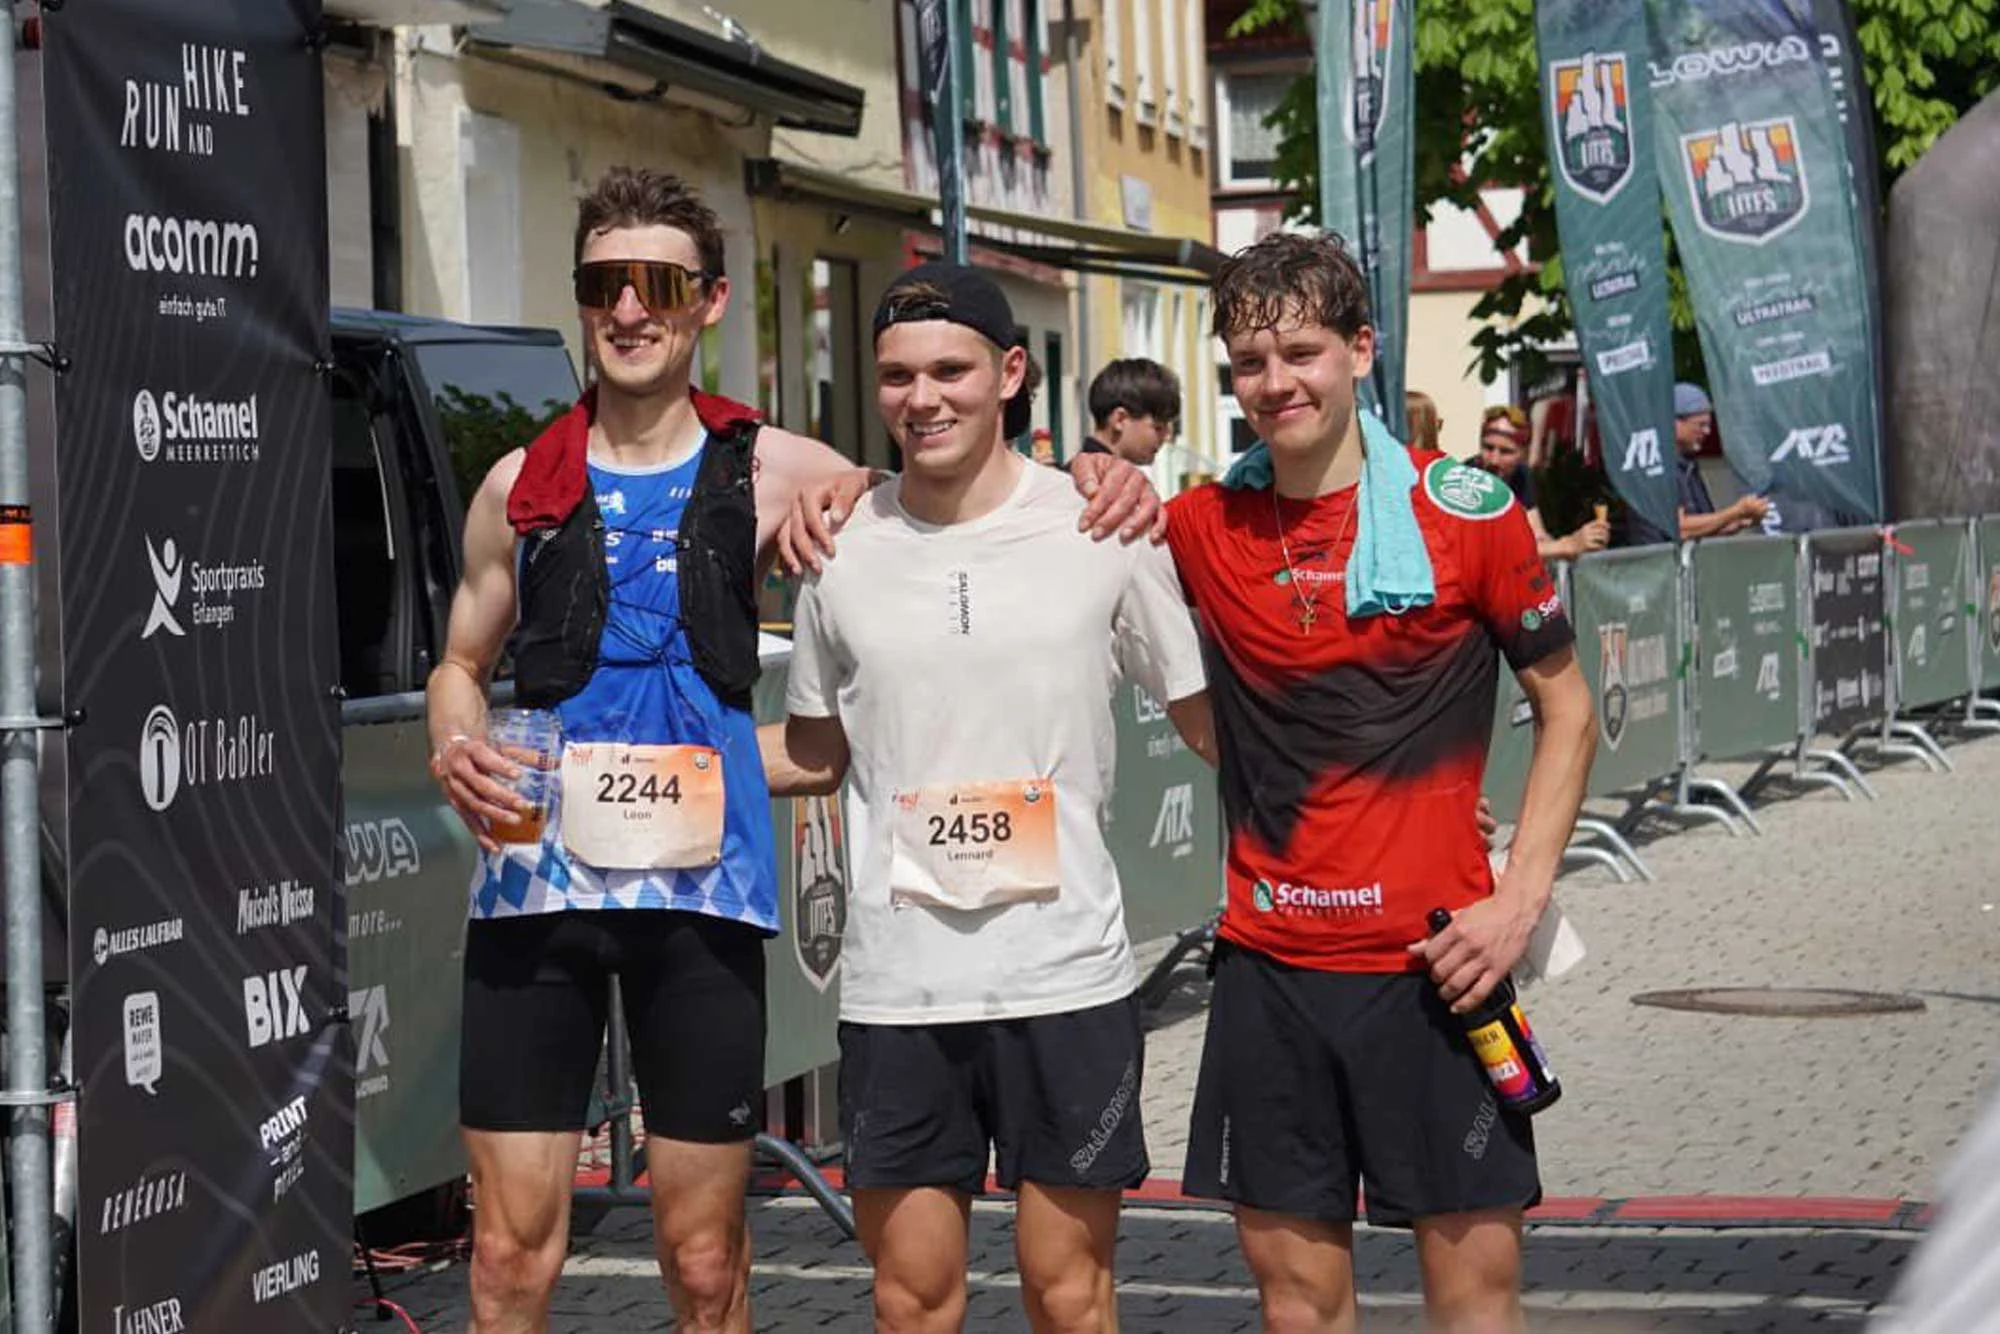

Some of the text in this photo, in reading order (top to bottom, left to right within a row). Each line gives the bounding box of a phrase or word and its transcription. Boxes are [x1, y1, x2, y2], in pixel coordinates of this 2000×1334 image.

[182, 43, 249, 115] HIKE
[121, 79, 180, 151] RUN
[162, 390, 259, 438] Schamel
[191, 558, 265, 600] Sportpraxis
[192, 601, 235, 629] Erlangen
[185, 721, 207, 785] OT
[597, 773, 682, 804] 2244
[623, 809, 653, 821] Leon
[928, 811, 1012, 845] 2458
[1276, 882, 1383, 907] Schamel
[243, 965, 311, 1048] BIX
[259, 1095, 308, 1150] PRINT
[251, 1249, 320, 1304] VIERLING
